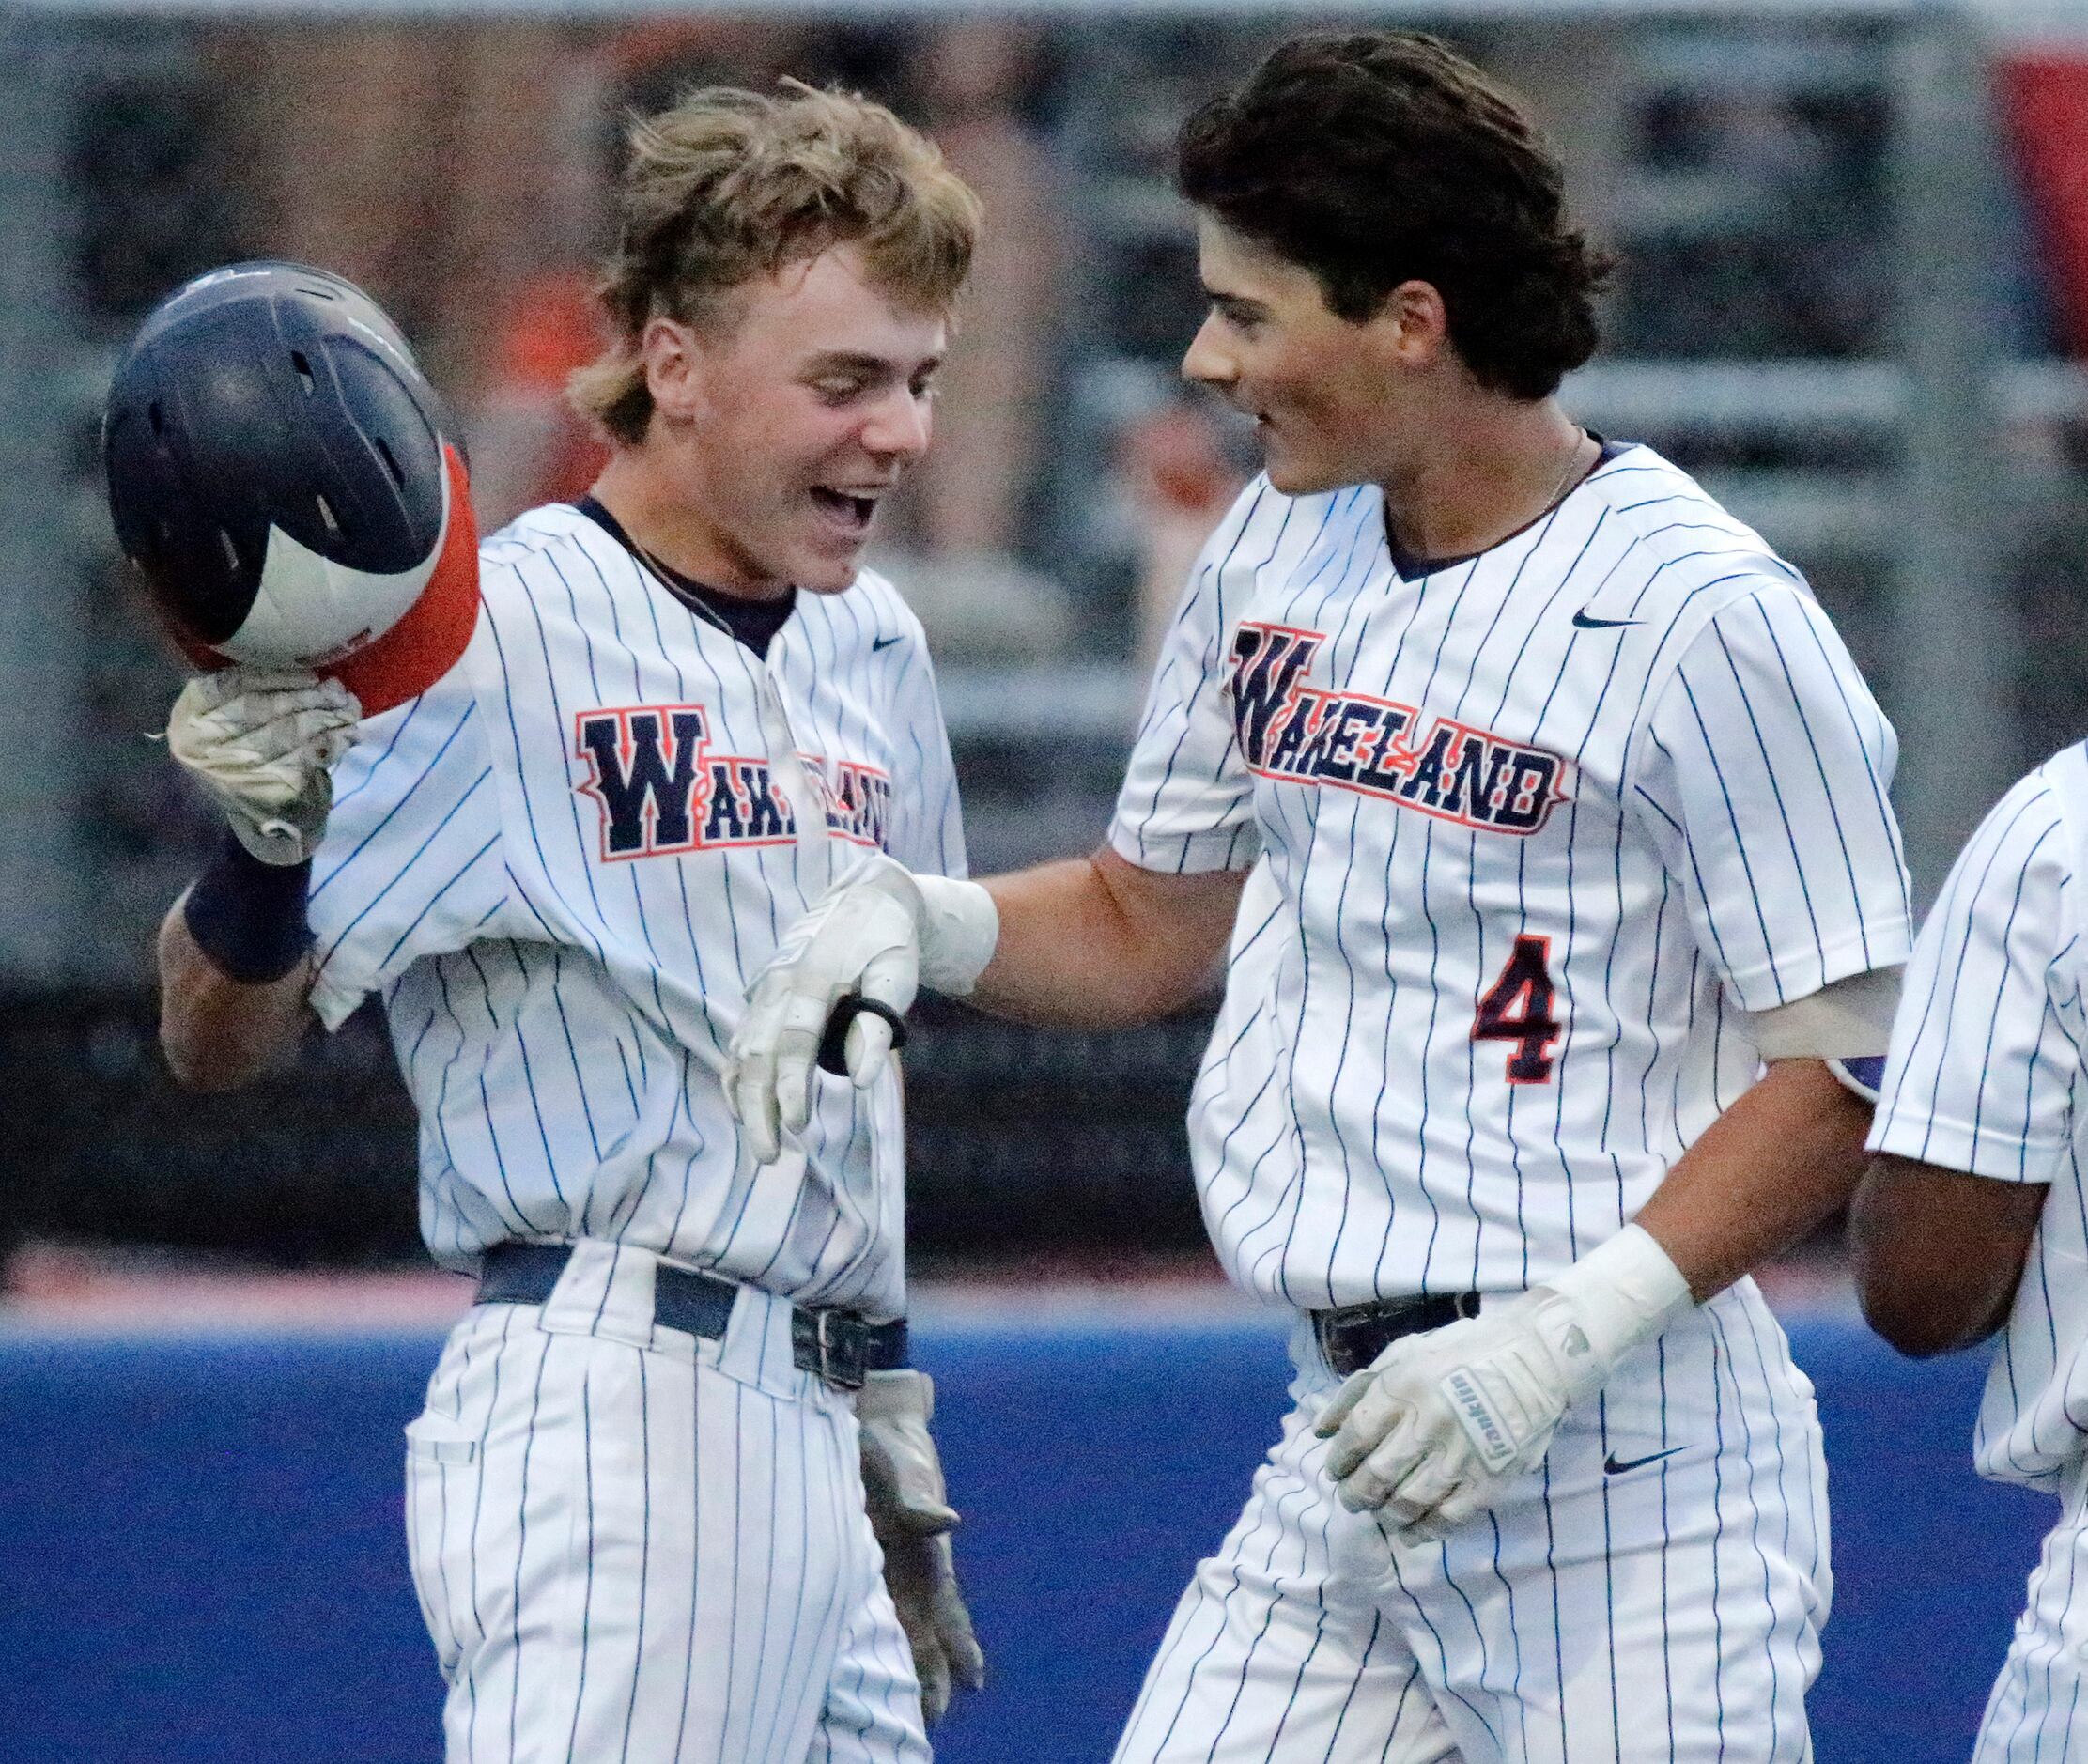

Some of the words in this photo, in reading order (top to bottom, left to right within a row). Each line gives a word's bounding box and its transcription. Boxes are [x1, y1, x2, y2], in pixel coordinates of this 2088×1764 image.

[1226, 623, 1570, 833] WAKELAND
[1471, 934, 1562, 1083] 4
[1449, 1373, 1513, 1460] Franklin
